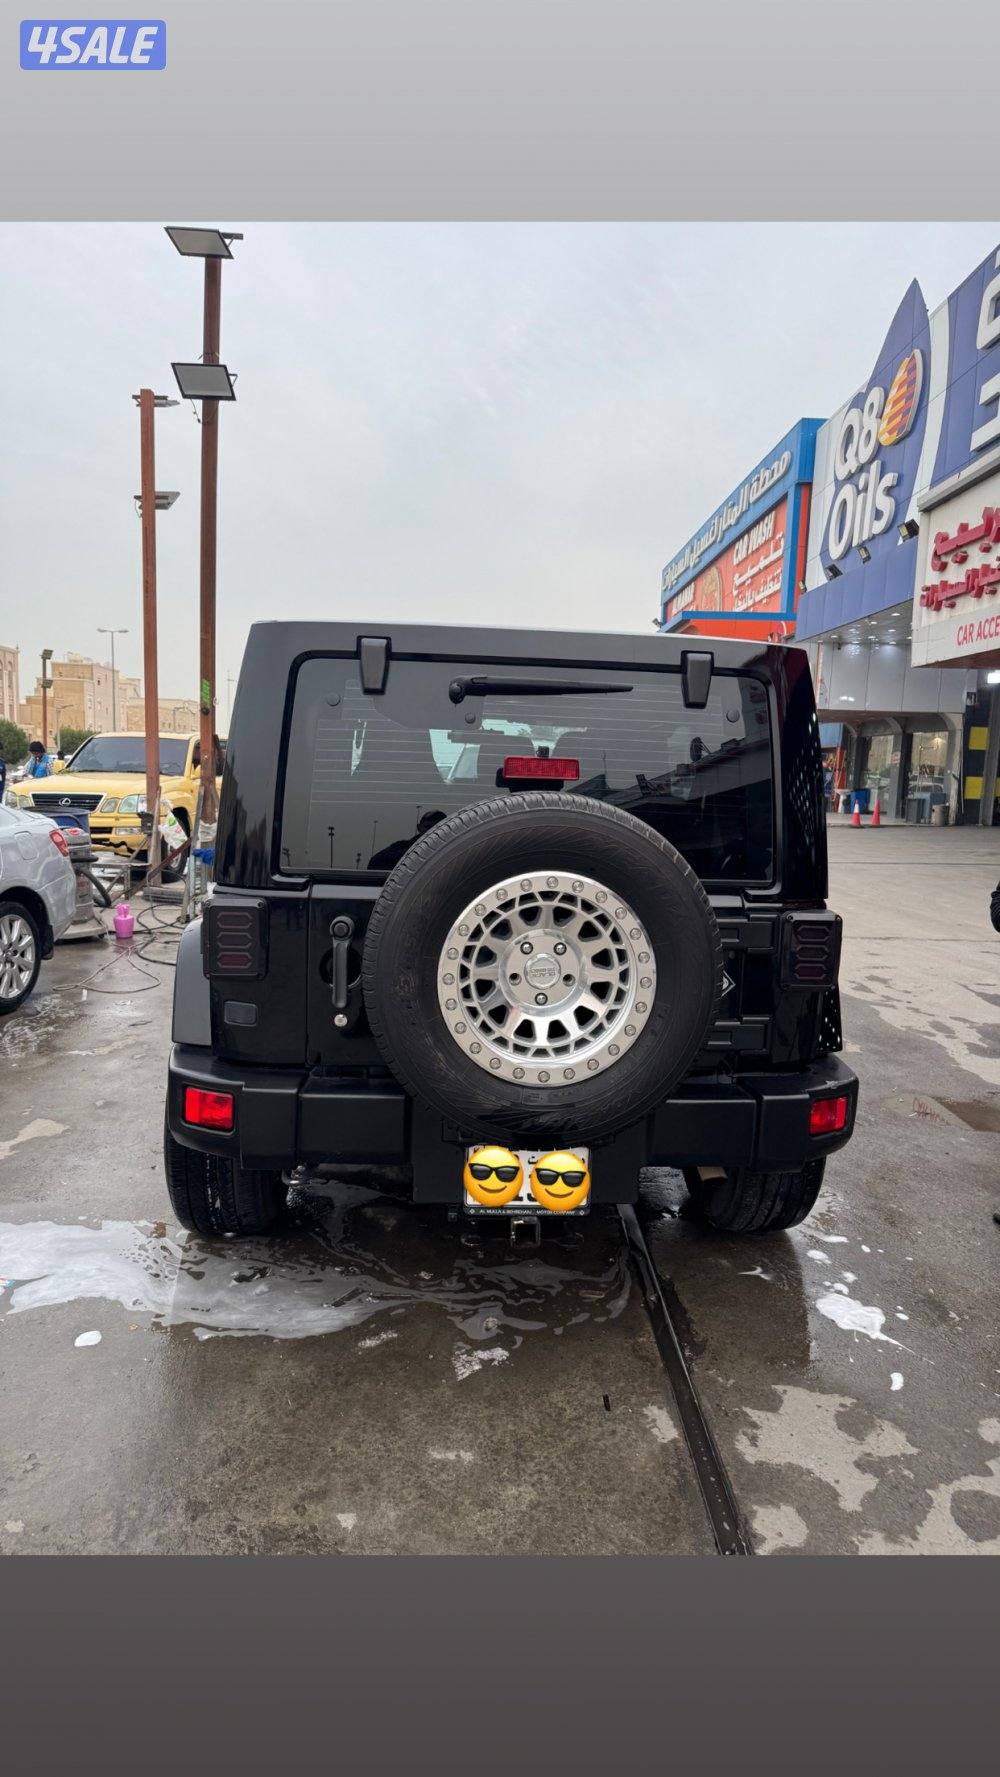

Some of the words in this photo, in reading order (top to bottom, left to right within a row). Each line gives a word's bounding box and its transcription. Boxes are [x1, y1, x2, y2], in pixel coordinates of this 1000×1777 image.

[834, 386, 885, 481] Q8
[749, 450, 791, 504] محطة
[732, 535, 750, 567] CAR
[748, 510, 777, 557] WASH
[828, 459, 899, 561] Oils
[957, 622, 974, 646] CAR
